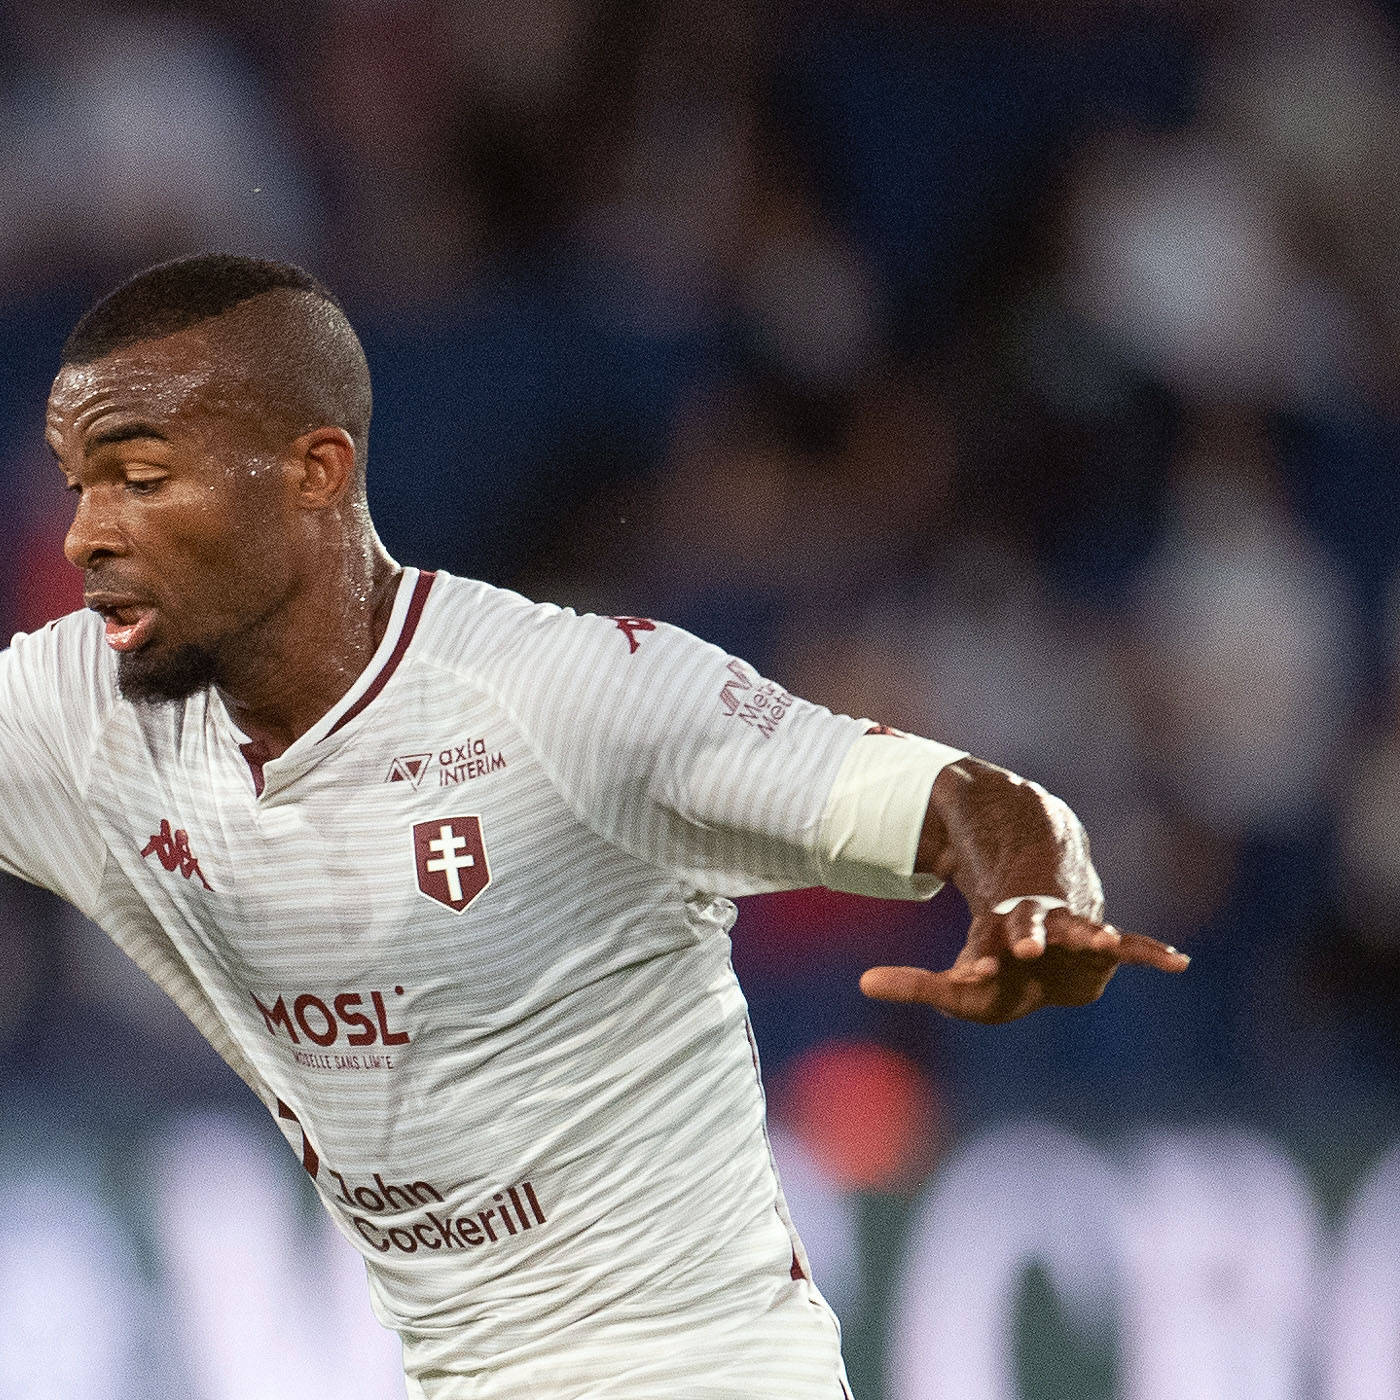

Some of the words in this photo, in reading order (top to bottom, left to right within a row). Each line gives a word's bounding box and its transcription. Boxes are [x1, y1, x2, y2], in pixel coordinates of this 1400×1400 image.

[438, 737, 486, 766] axia
[438, 751, 507, 787] INTERIM
[333, 1055, 360, 1070] SANS
[328, 1168, 447, 1213] John
[352, 1180, 548, 1254] Cockerill
